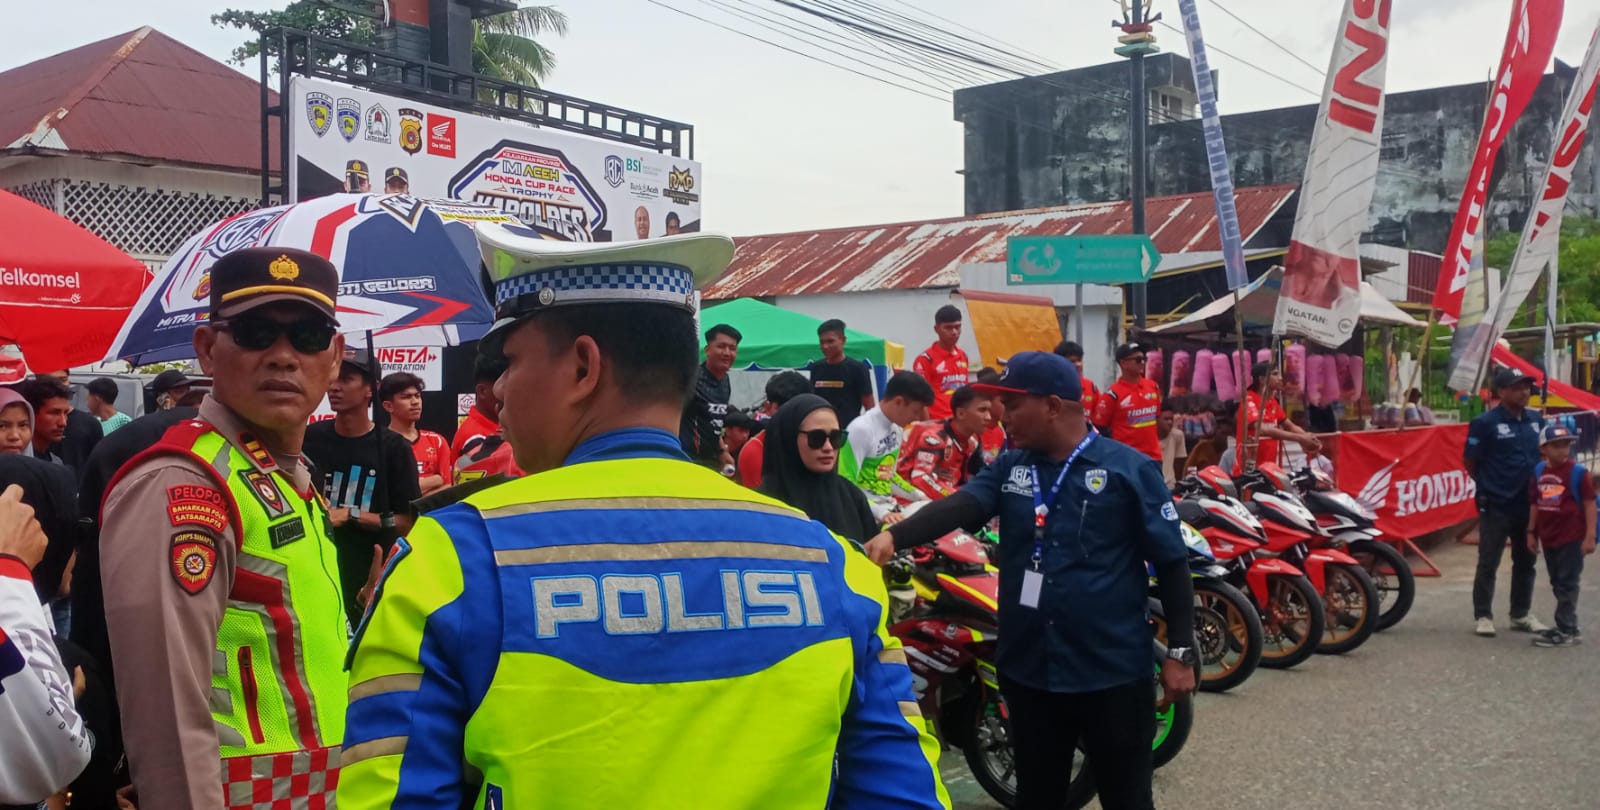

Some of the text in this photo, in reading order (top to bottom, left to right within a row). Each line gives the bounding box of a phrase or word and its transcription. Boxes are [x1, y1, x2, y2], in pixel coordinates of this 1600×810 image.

[502, 159, 560, 182] IMI ACEH
[626, 158, 641, 173] BSI
[484, 173, 576, 195] HONDA CUP RACE
[510, 186, 554, 199] TROPHY
[0, 267, 80, 289] Telkomsel
[377, 345, 428, 363] INSTA
[380, 363, 426, 371] ENERATION
[174, 486, 222, 505] PELOPO
[1394, 469, 1477, 517] HONDA
[530, 569, 825, 639] POLISI
